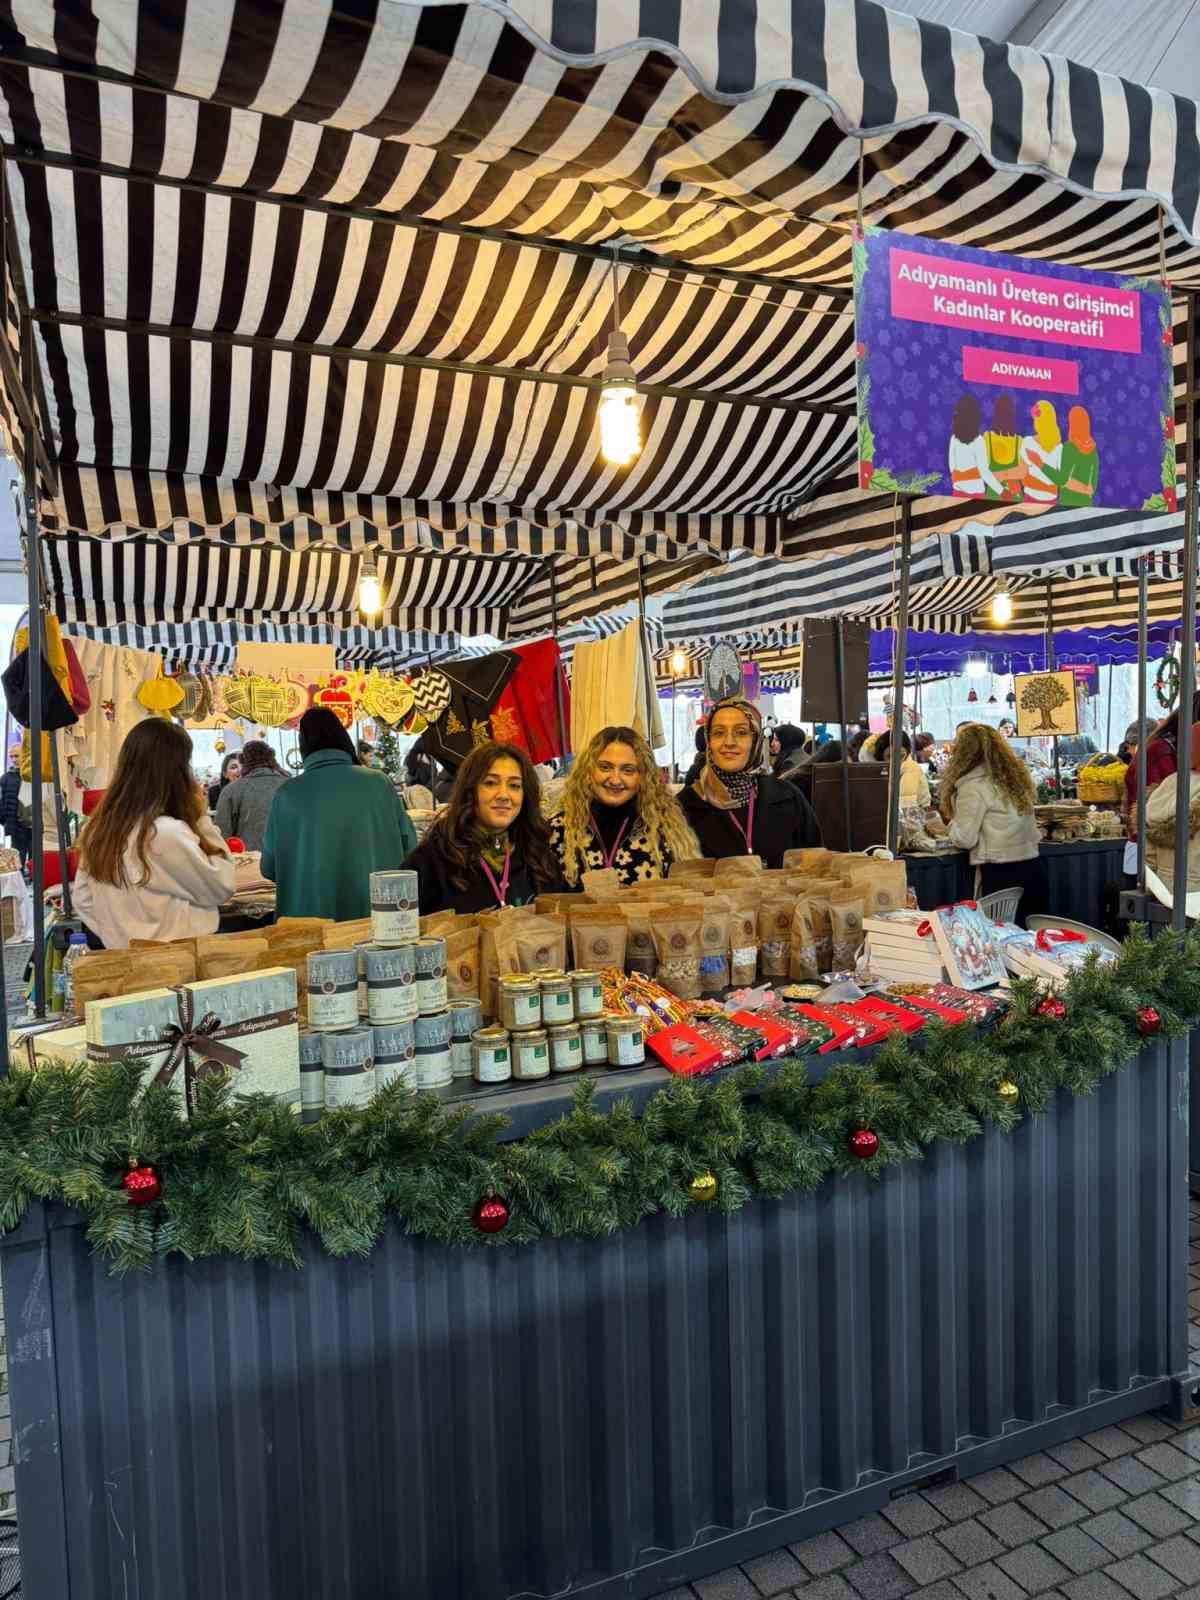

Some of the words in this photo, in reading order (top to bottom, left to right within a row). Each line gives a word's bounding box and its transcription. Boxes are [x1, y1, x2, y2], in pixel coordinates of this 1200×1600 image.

[898, 264, 997, 297] Adıyamanlı
[1002, 280, 1058, 307] Üreten
[1063, 293, 1134, 318] Girişimci
[933, 296, 1005, 323] Kadınlar
[1010, 309, 1103, 337] Kooperatifi
[991, 361, 1052, 381] ADIYAMAN
